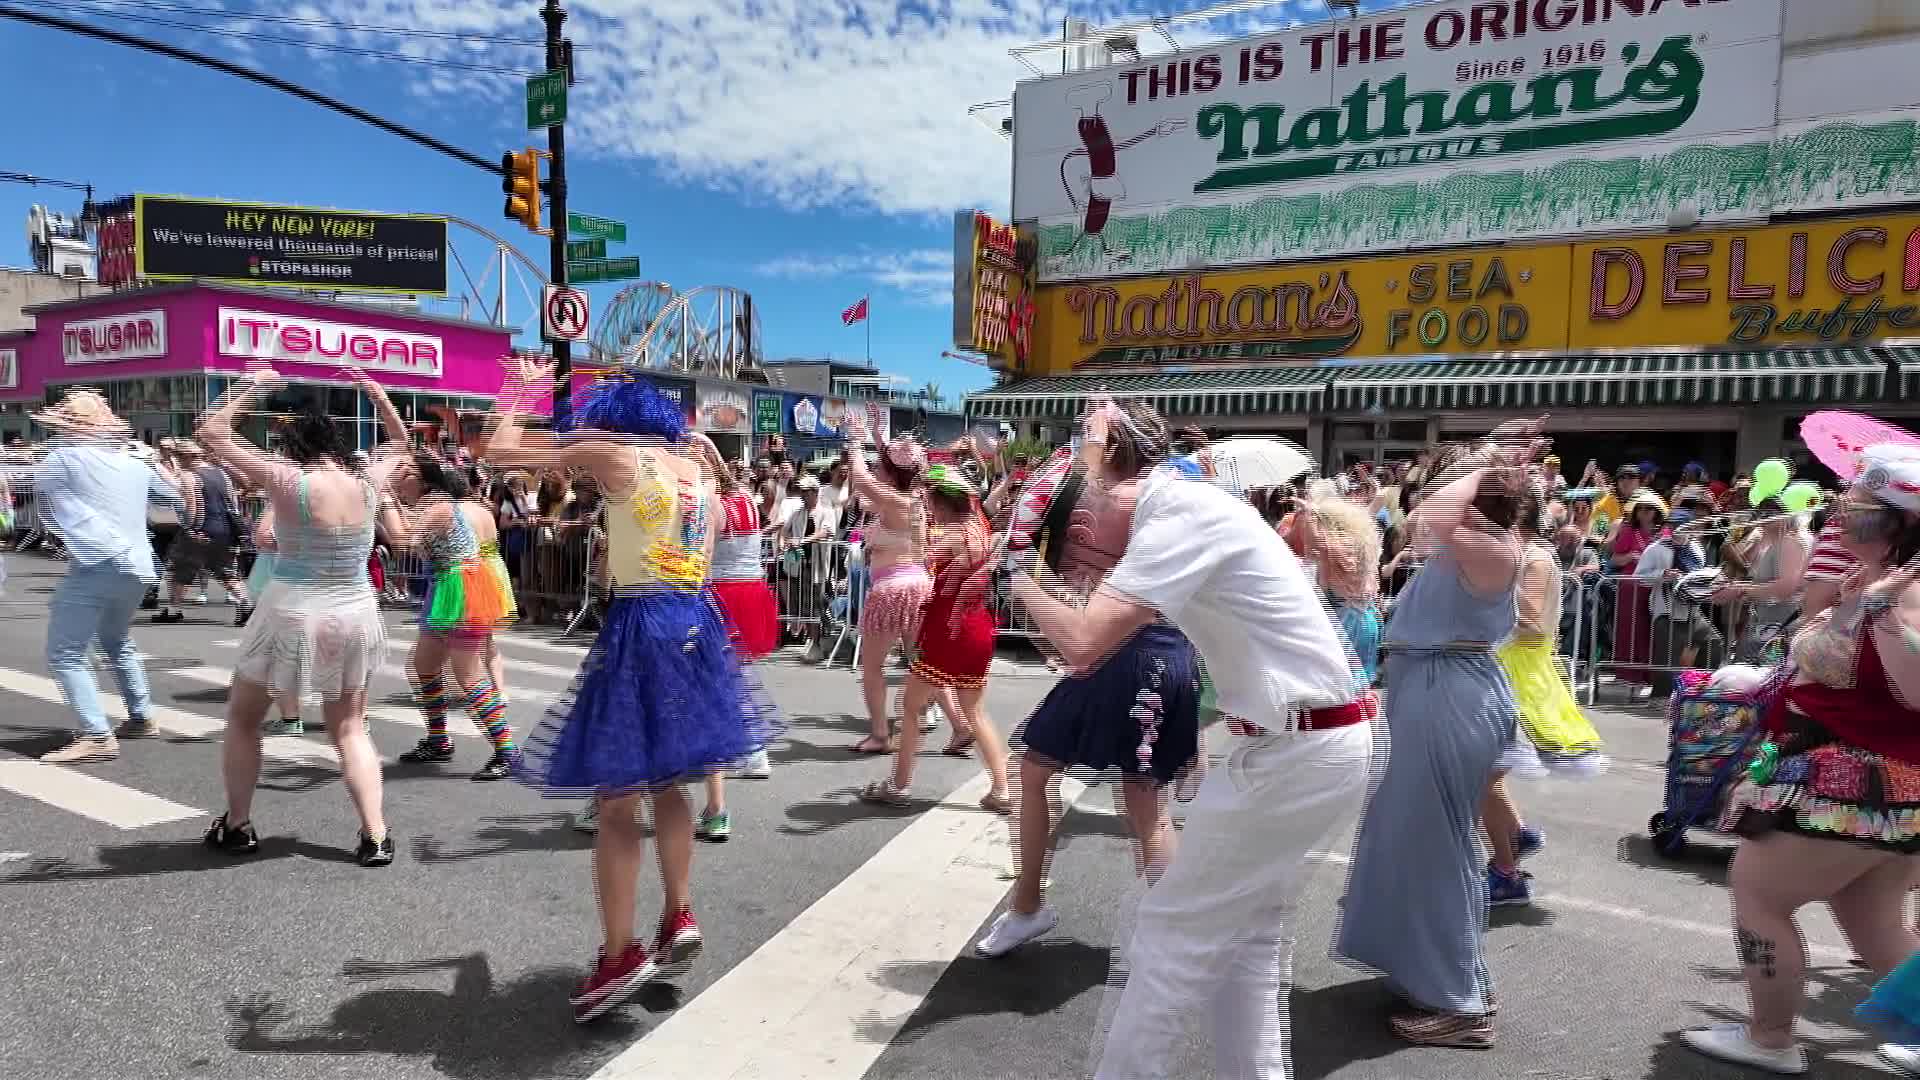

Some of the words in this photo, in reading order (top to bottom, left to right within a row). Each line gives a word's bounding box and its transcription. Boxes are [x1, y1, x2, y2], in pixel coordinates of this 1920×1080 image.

[1120, 55, 1222, 103] THIS
[1238, 43, 1284, 86] IS
[1300, 20, 1406, 73] THE
[1424, 0, 1728, 51] ORIGI
[1456, 57, 1526, 82] Since
[1544, 40, 1607, 67] 1916
[1335, 134, 1506, 172] FAMOUS
[152, 227, 203, 247] We've
[207, 231, 274, 252] lowered
[279, 236, 363, 257] thousands
[367, 242, 385, 259] of
[386, 245, 439, 264] prices!
[225, 210, 266, 233] HEY
[272, 215, 315, 235] NEW
[320, 218, 376, 240] YORK!
[1407, 257, 1513, 304] SEA
[1590, 224, 1920, 321] DELIC
[226, 316, 439, 370] IT'SUGAR
[1384, 303, 1529, 350] FOOD
[1122, 342, 1244, 363] FAMOUS
